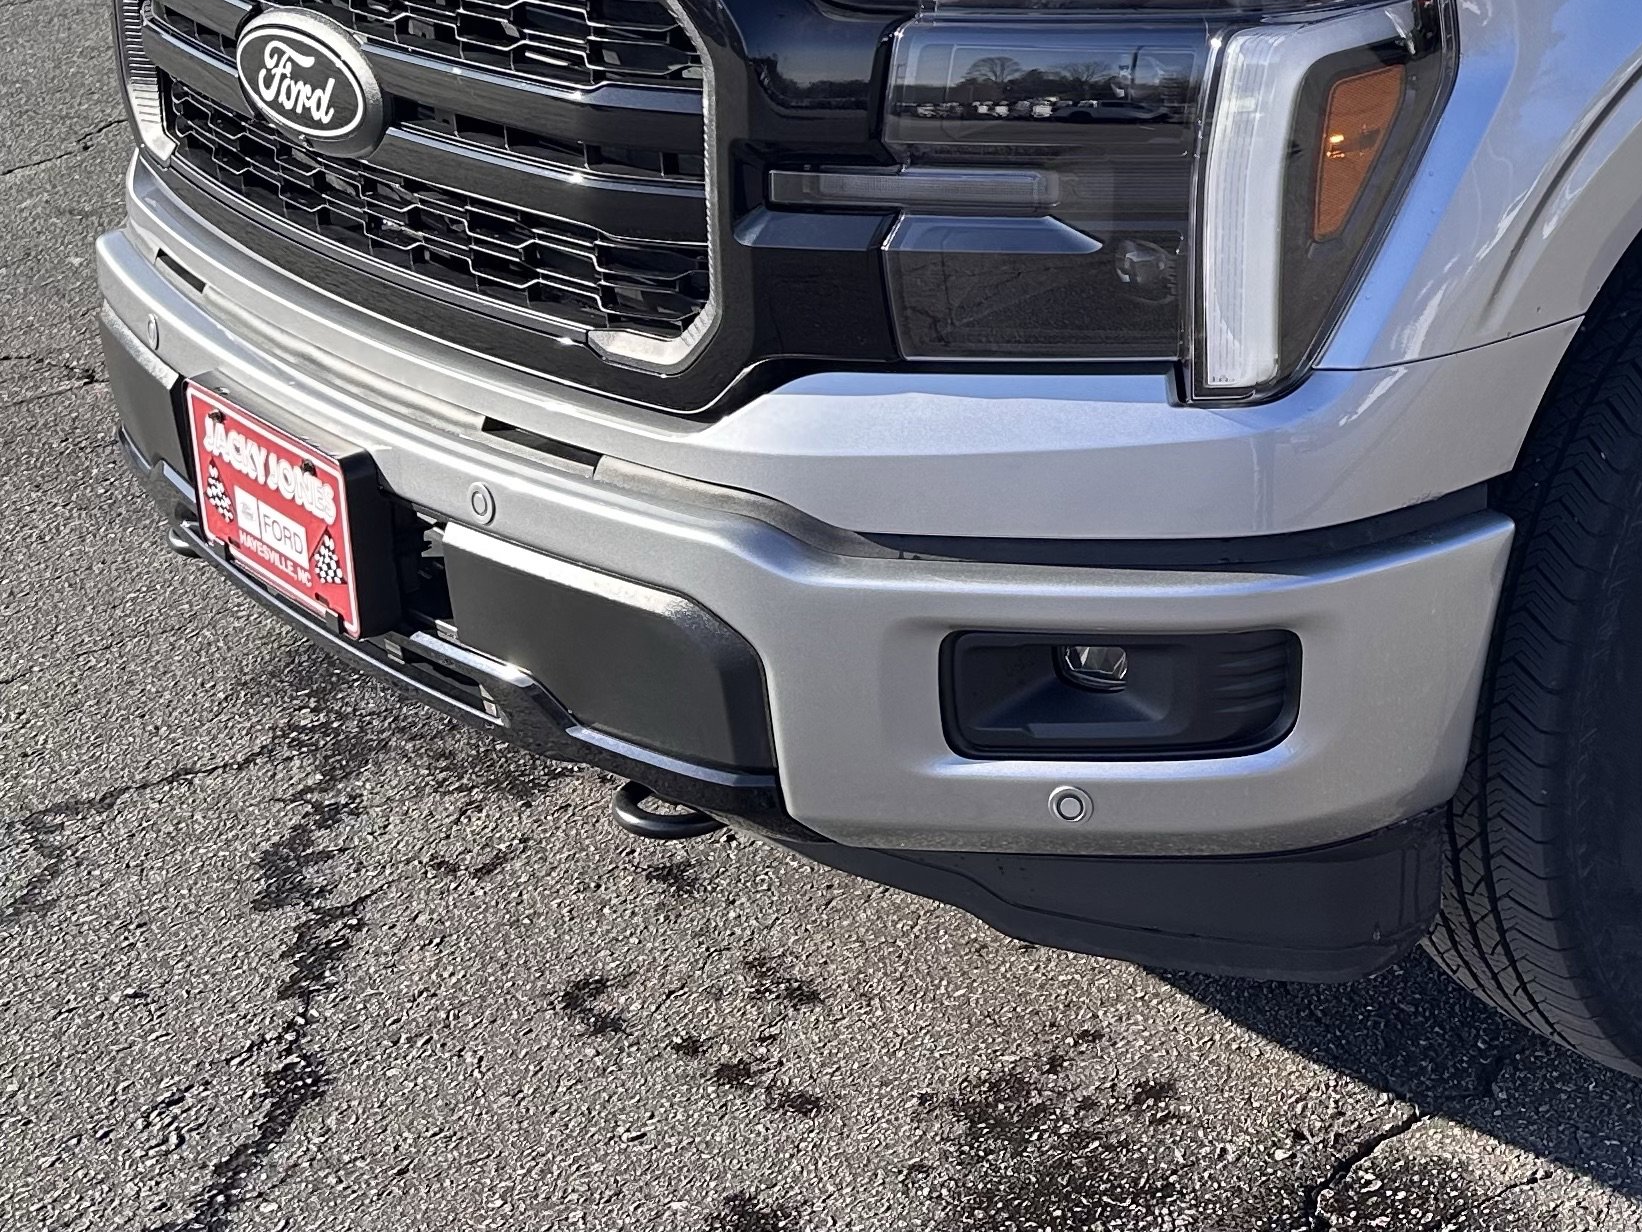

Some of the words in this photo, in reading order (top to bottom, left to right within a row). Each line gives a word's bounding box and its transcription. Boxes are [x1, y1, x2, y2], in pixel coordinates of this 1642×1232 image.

[258, 40, 336, 124] Ford
[203, 416, 268, 485] JACKY
[267, 452, 337, 525] JONES
[262, 513, 304, 555] FORD
